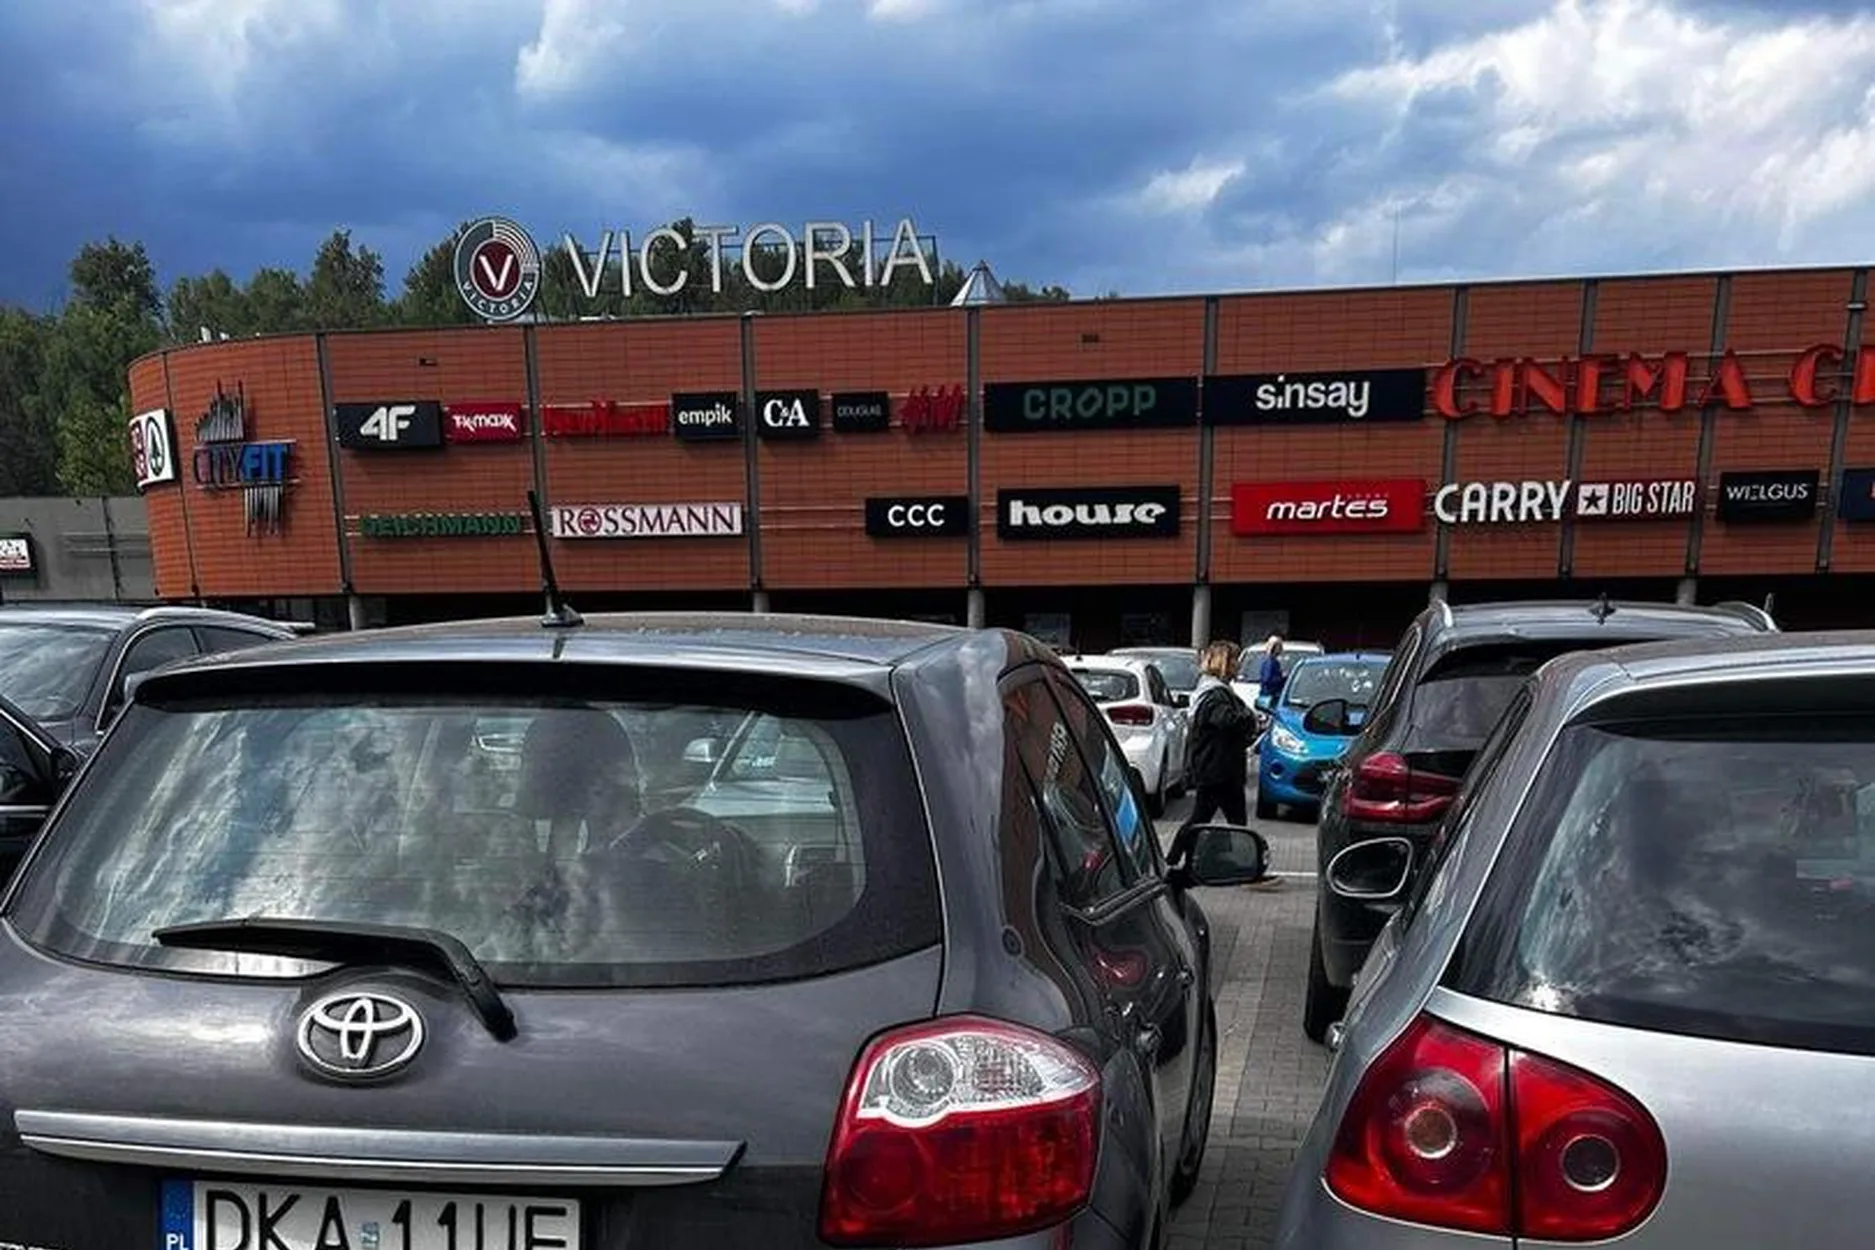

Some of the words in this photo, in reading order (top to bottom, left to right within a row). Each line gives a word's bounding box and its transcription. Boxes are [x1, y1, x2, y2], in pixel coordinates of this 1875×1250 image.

[479, 254, 514, 291] V
[564, 218, 934, 298] VICTORIA
[462, 281, 533, 313] VICTORIA
[1255, 375, 1371, 417] sinsay
[1433, 348, 1754, 419] CINEMA
[678, 402, 733, 427] empik
[763, 399, 810, 427] C&A
[1023, 384, 1157, 420] CROPP
[360, 405, 416, 441] 4F
[1266, 494, 1388, 520] martes
[1434, 480, 1573, 523] CARRY
[1612, 484, 1643, 515] BIG
[1647, 481, 1696, 514] STAR
[1726, 482, 1809, 501] WIELGUS
[559, 505, 736, 536] ROSSMANN
[888, 503, 945, 527] CCC
[1009, 499, 1167, 526] house
